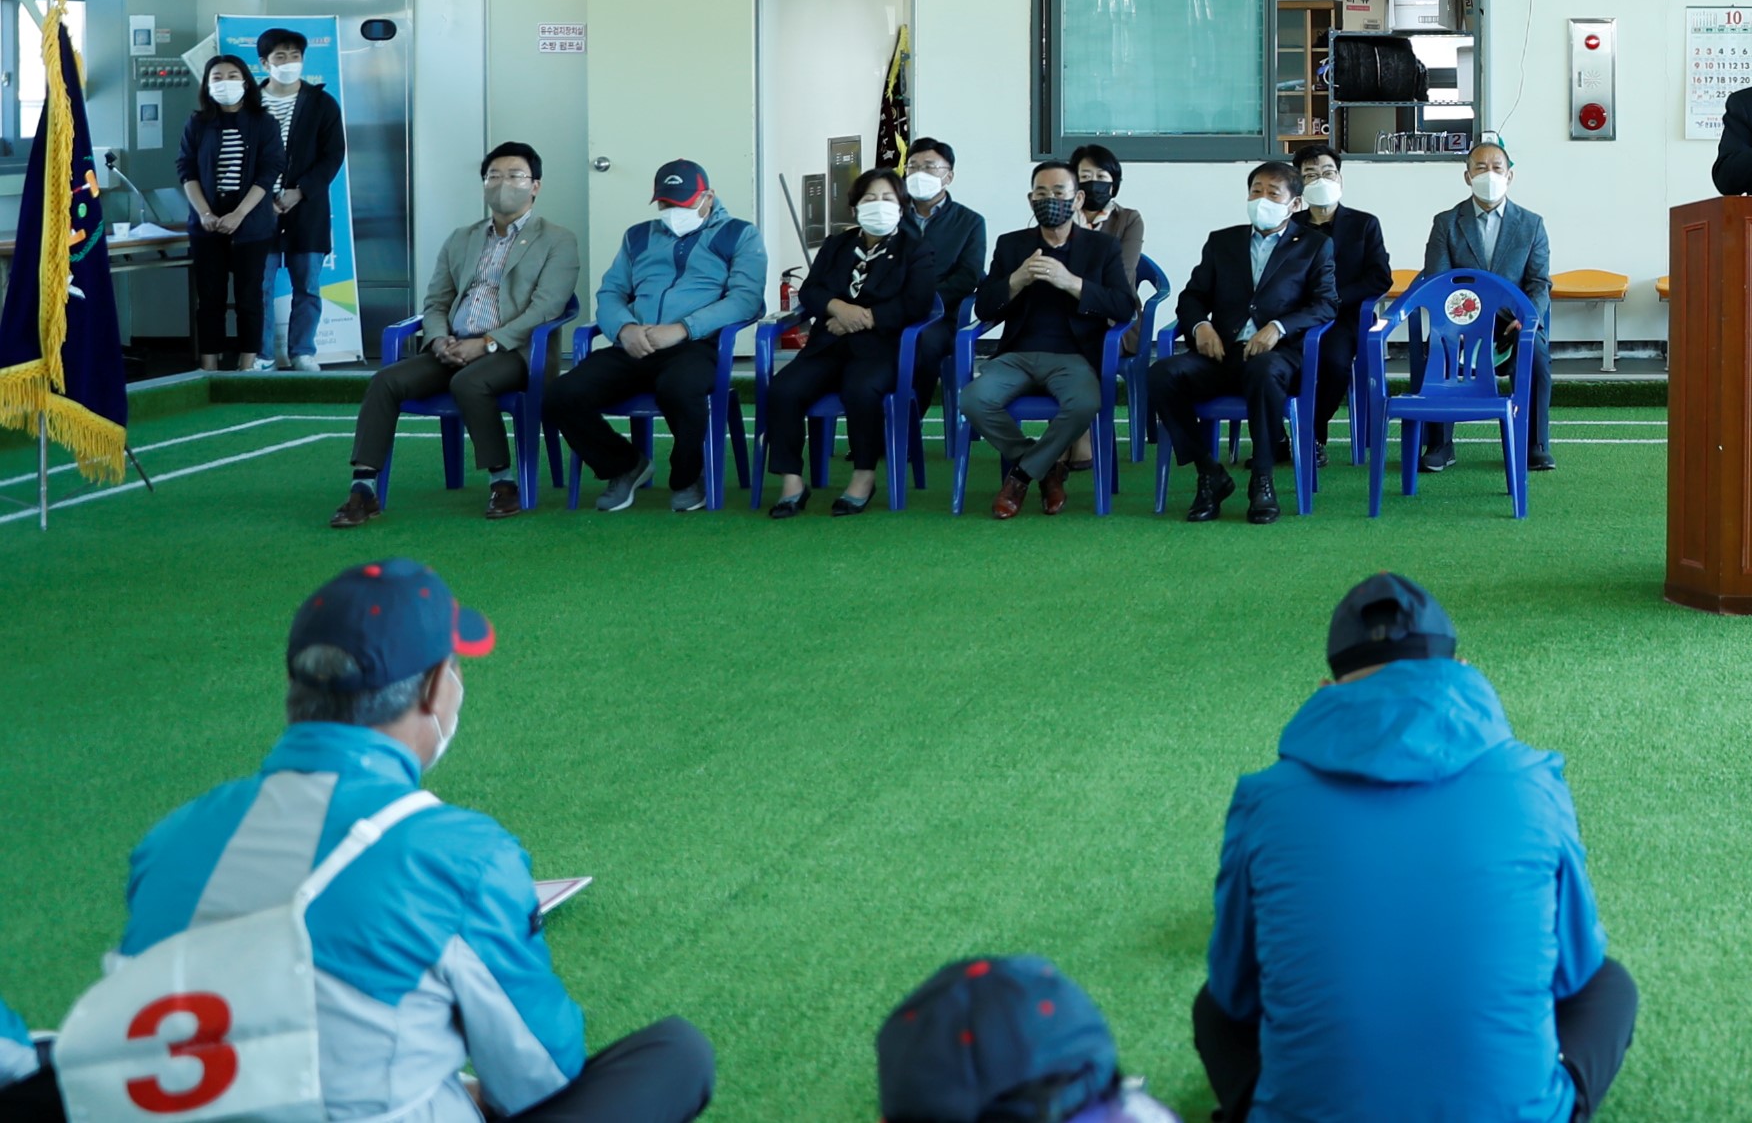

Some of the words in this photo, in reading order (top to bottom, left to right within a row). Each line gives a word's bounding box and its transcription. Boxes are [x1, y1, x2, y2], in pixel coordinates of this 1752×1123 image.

[1725, 10, 1742, 25] 10
[541, 42, 556, 50] 소방
[1693, 76, 1702, 84] 16
[1704, 76, 1714, 84] 17
[1716, 76, 1726, 84] 18
[1728, 76, 1738, 84] 19
[1740, 76, 1750, 84] 20
[1452, 134, 1461, 146] 2
[126, 992, 239, 1113] 3
